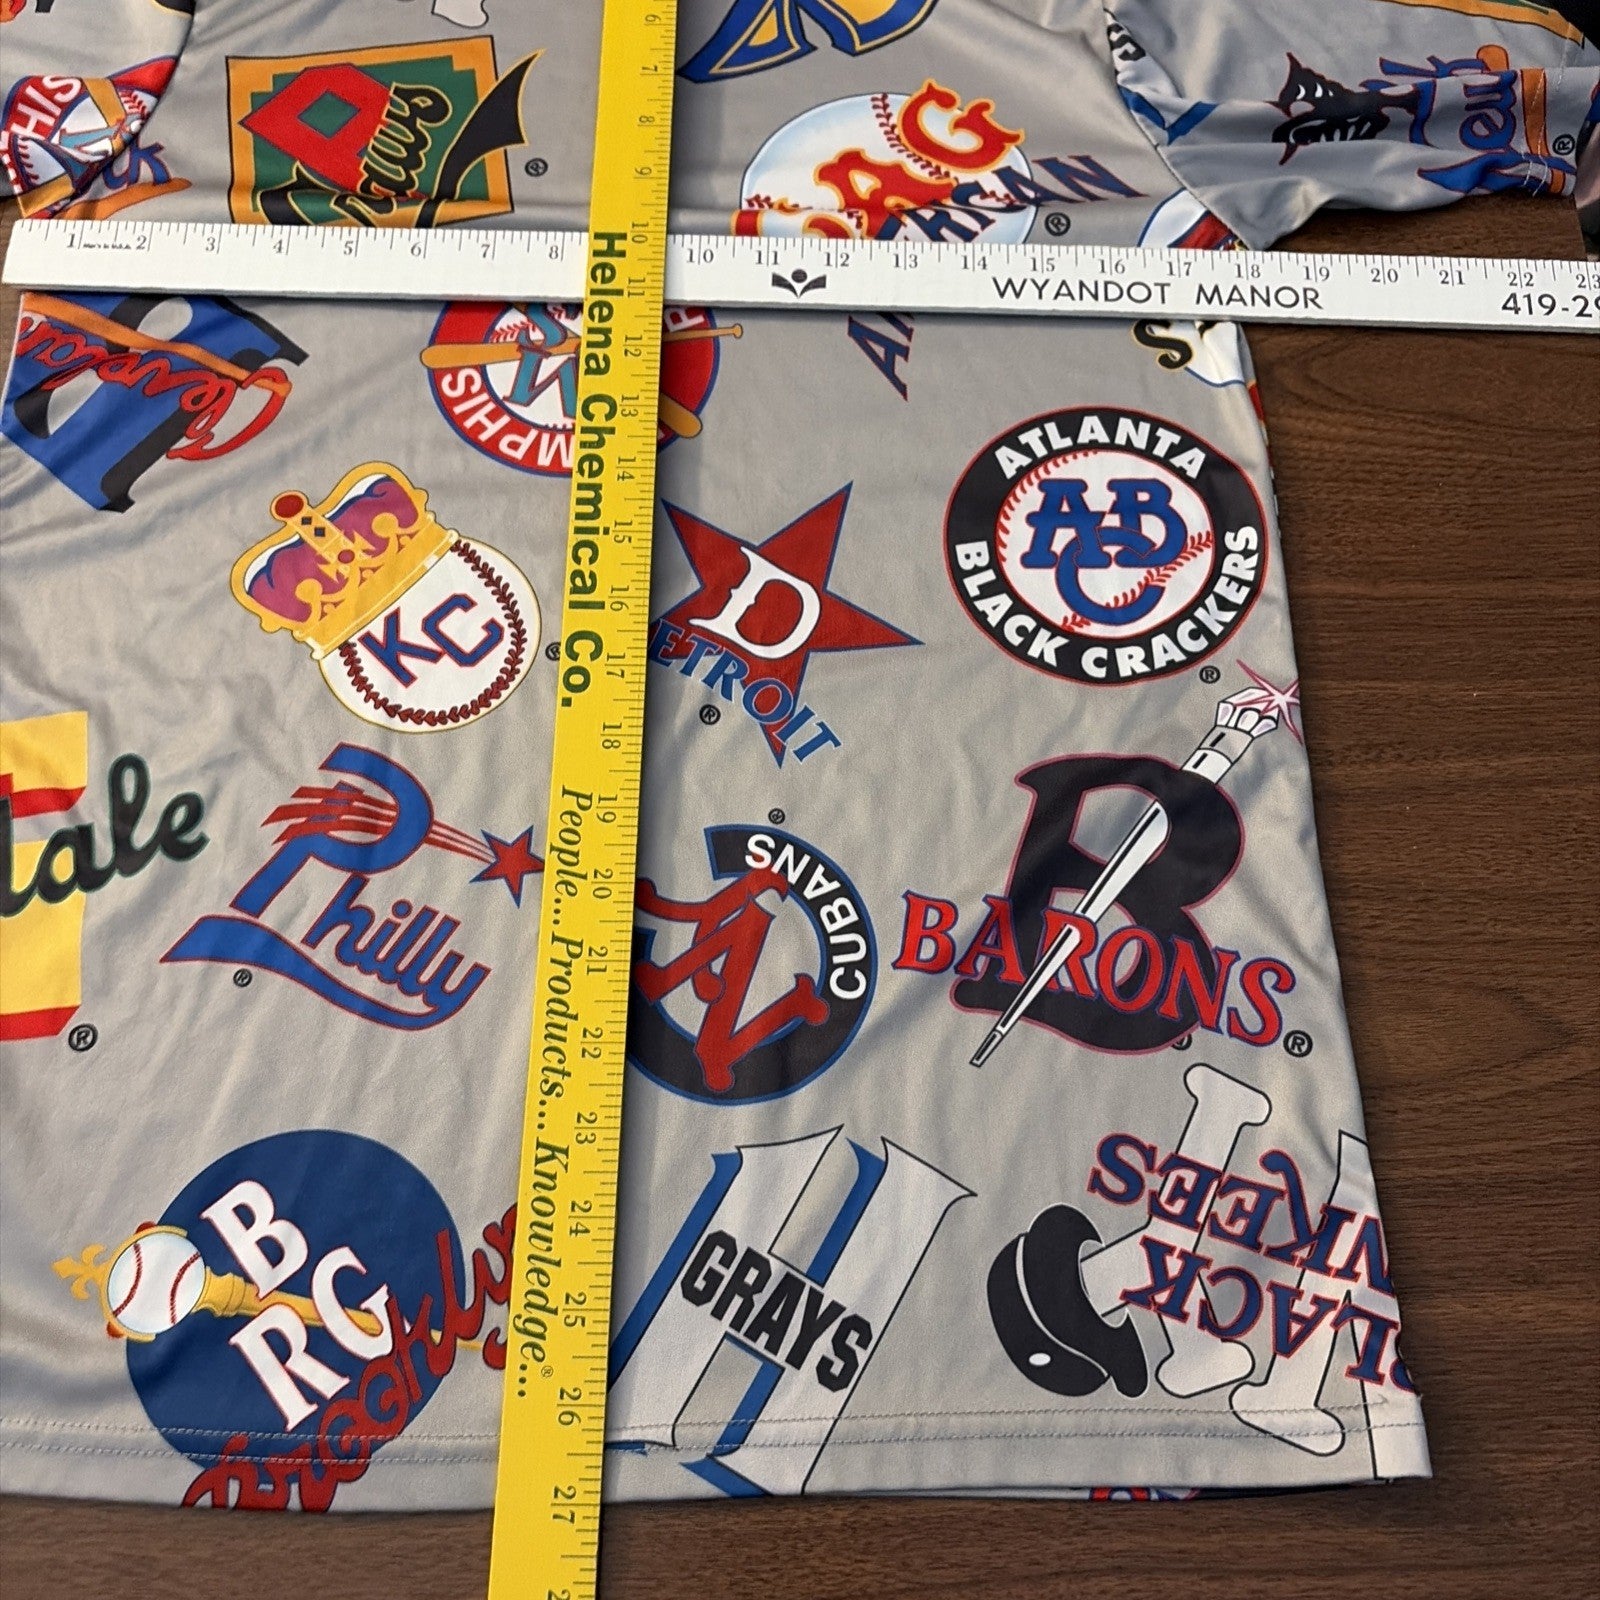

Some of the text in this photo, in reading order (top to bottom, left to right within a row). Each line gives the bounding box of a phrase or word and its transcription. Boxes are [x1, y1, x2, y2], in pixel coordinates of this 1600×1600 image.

[631, 221, 649, 244] 10
[66, 233, 76, 249] 1
[136, 235, 148, 250] 2
[205, 237, 216, 252] 3
[273, 239, 284, 254] 4
[343, 241, 354, 256] 5
[411, 242, 422, 257] 6
[481, 244, 491, 259] 7
[548, 245, 559, 260] 8
[686, 249, 715, 264] 10
[755, 250, 780, 265] 11
[824, 252, 850, 267] 12
[893, 253, 918, 269] 13
[961, 254, 988, 271] 14
[1029, 256, 1056, 272] 15
[1098, 258, 1126, 275] 16
[1166, 260, 1193, 277] 17
[1234, 262, 1261, 279] 18
[1303, 265, 1331, 281] 19
[1370, 267, 1399, 283] 20
[1439, 269, 1466, 285] 21
[1507, 271, 1535, 288] 22
[627, 277, 646, 298] 11
[992, 276, 1171, 305] WYANDOT
[1195, 284, 1324, 311] MANOR
[623, 334, 642, 358] 12
[441, 367, 576, 469] MPHIS
[620, 395, 639, 418] 13
[993, 414, 1208, 480] ATLANTA
[561, 231, 628, 708] Helena Chemical Co.
[617, 457, 636, 482] 14
[613, 520, 633, 544] 15
[609, 585, 629, 612] 16
[688, 546, 823, 660] D
[954, 525, 1261, 680] BLACK CRACKERS
[357, 593, 505, 688] KC
[606, 652, 626, 679] 17
[650, 617, 843, 765] ETROIT
[602, 721, 623, 750] 18
[596, 794, 618, 824] 19
[592, 868, 614, 900] 20
[745, 833, 867, 1001] CUBANS
[586, 946, 608, 975] 21
[890, 889, 1296, 1049] BARONS
[581, 1027, 603, 1059] 22
[575, 1111, 598, 1145] 23
[569, 1200, 593, 1237] 24
[1086, 1131, 1397, 1300] NKEES
[202, 1180, 309, 1300] B
[563, 1291, 587, 1328] 25
[680, 1229, 874, 1393] GRAYS
[1119, 1234, 1418, 1396] LACK
[558, 1387, 582, 1426] 26
[552, 1485, 577, 1524] 27
